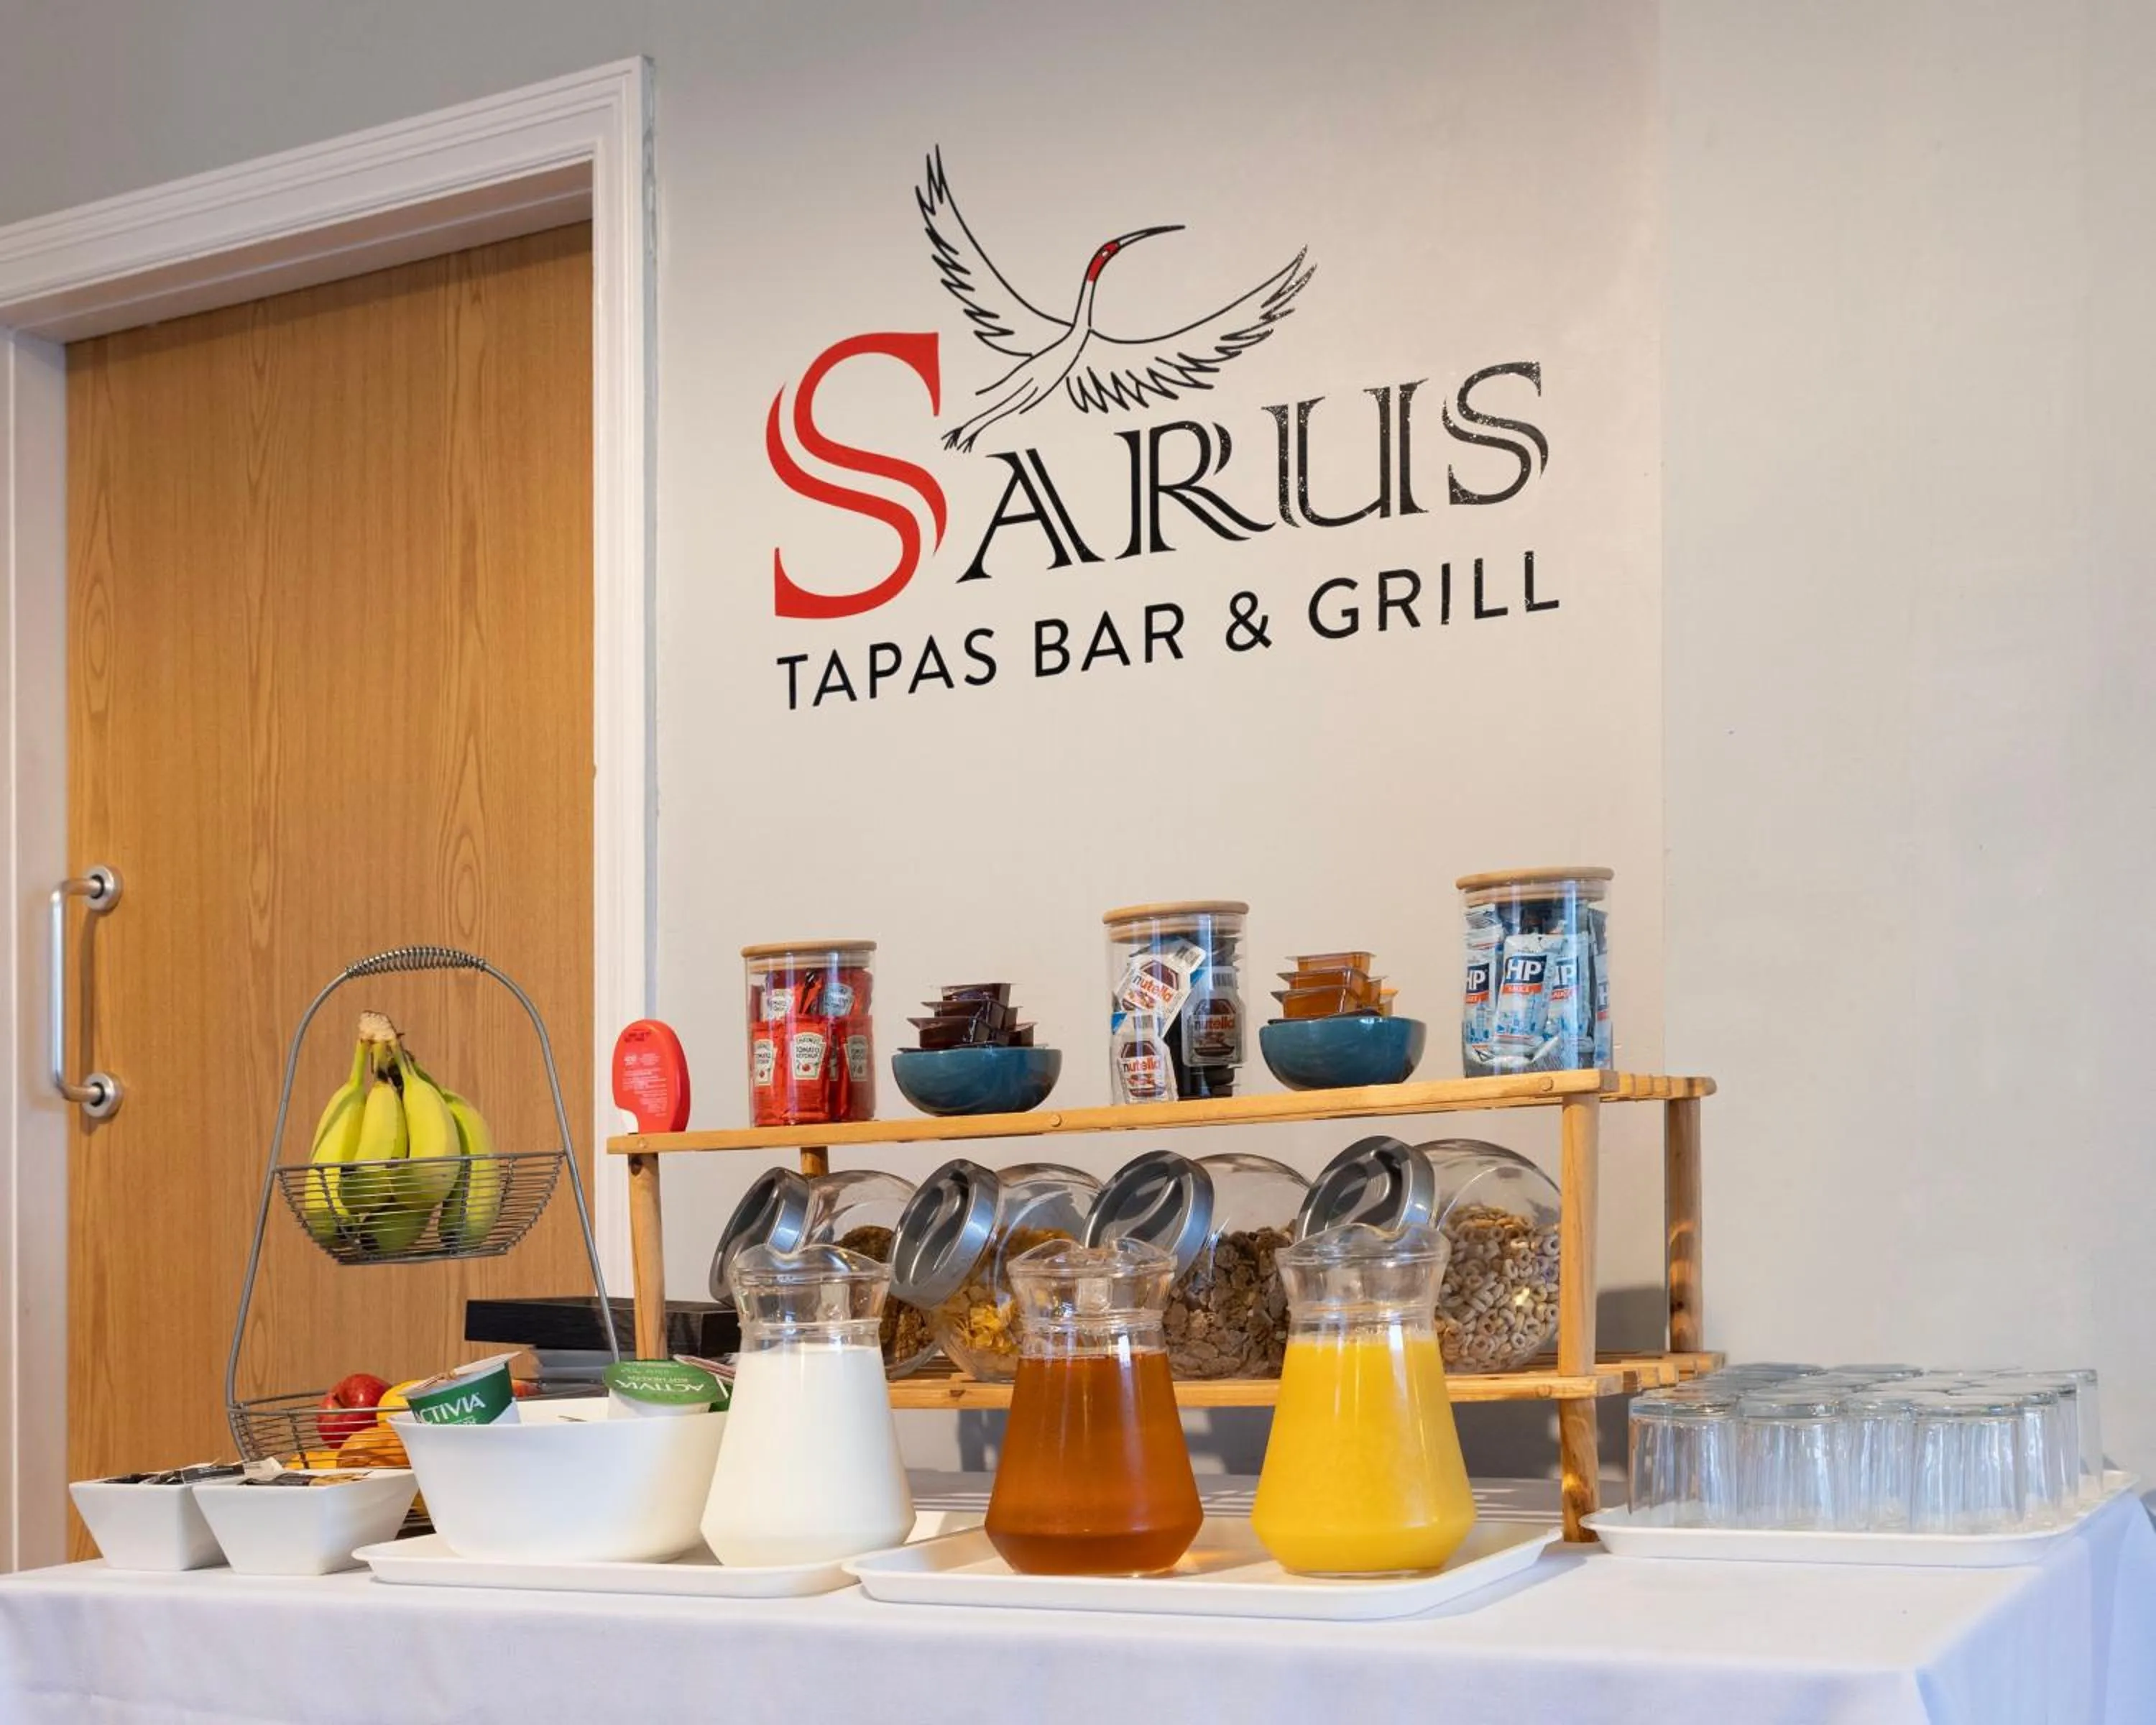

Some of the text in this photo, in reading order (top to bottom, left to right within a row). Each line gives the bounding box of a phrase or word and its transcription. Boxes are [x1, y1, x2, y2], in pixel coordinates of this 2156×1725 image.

[766, 332, 1549, 620] SARUS
[777, 551, 1560, 710] TAPAS BAR & GRILL
[1506, 958, 1542, 982] HP
[1130, 975, 1174, 1004] nutella
[1194, 1016, 1235, 1031] nutella
[1123, 1057, 1161, 1072] nutella
[614, 1379, 704, 1392] ACTIVIA
